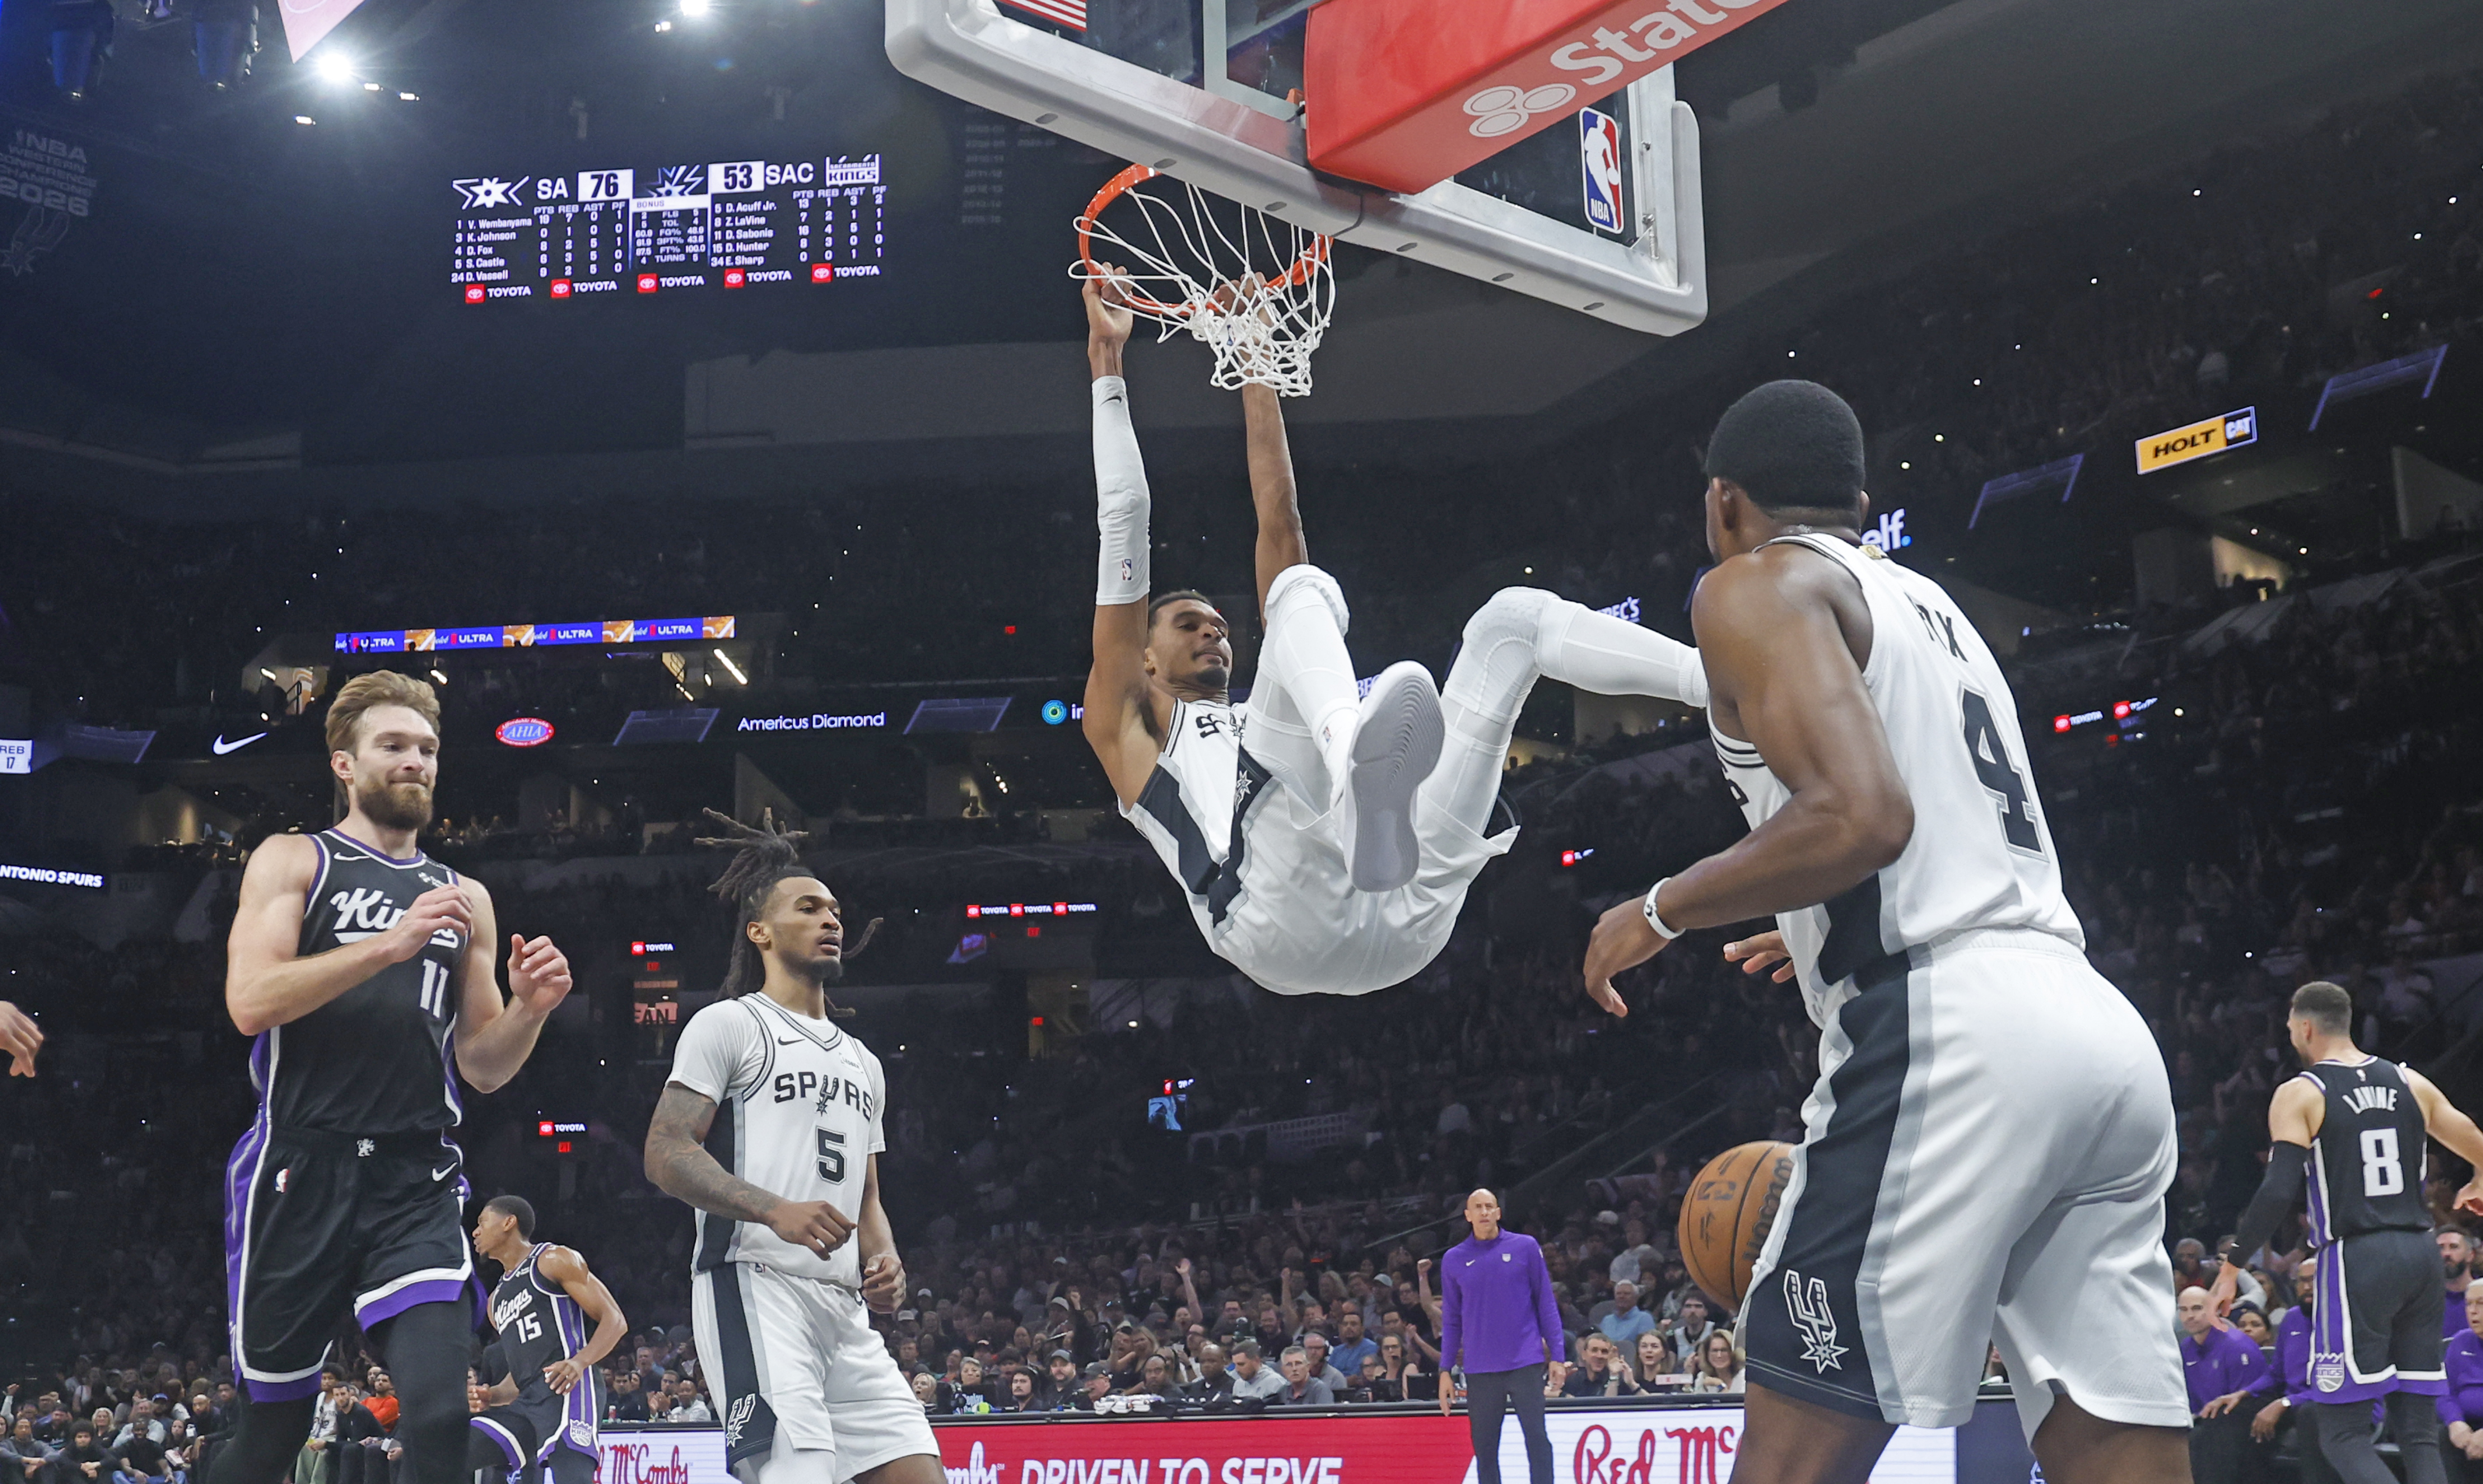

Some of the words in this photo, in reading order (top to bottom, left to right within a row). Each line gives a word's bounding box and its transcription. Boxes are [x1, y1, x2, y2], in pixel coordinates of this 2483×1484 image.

[1550, 0, 1760, 86] Stat
[26, 132, 87, 164] NBA
[9, 144, 85, 174] WESTERN
[724, 164, 753, 190] 53
[766, 162, 814, 185] SAC
[829, 169, 876, 181] KINGS
[537, 177, 568, 199] SA
[591, 173, 618, 198] 76
[793, 190, 814, 199] PTS
[818, 188, 840, 198] REB
[843, 187, 865, 196] AST
[872, 186, 886, 195] PF
[0, 176, 88, 216] 2026
[725, 202, 735, 213] D.
[736, 200, 762, 213] Acuff
[763, 200, 777, 211] Jr.
[799, 199, 809, 209] 13
[827, 197, 831, 207] 1
[850, 196, 857, 206] 3
[875, 194, 883, 204] 2
[534, 206, 554, 215] PTS
[558, 205, 579, 213] REB
[584, 203, 604, 212] AST
[612, 202, 625, 210] PF
[642, 212, 647, 220] 2
[725, 217, 734, 227] Z.
[735, 216, 766, 226] LaVine
[800, 212, 808, 222] 7
[825, 210, 832, 221] 2
[851, 209, 856, 219] 1
[877, 208, 882, 218] 1
[1590, 198, 1610, 223] NBA
[457, 220, 462, 229] 1
[468, 220, 476, 229] V.
[479, 218, 532, 230] Wembanyama
[566, 213, 572, 223] 7
[591, 212, 598, 221] 0
[617, 210, 622, 220] 1
[456, 233, 463, 242] 3
[467, 232, 476, 242] K.
[477, 232, 516, 241] Johnson
[540, 228, 548, 238] 0
[567, 227, 571, 236] 1
[590, 225, 598, 235] 0
[615, 223, 623, 233] 0
[659, 228, 681, 237] FG%
[714, 231, 721, 240] 11
[725, 231, 735, 241] D.
[736, 228, 774, 238] Sabonis
[824, 225, 832, 234] 4
[877, 221, 881, 231] 1
[455, 246, 462, 256] 4
[467, 246, 476, 256] D.
[477, 246, 493, 255] Fox
[565, 240, 572, 250] 2
[590, 238, 598, 248] 5
[616, 237, 621, 246] 1
[656, 237, 684, 245] 3PT%
[686, 244, 706, 253] 100.0
[713, 243, 722, 253] 15
[725, 243, 735, 253] D.
[736, 242, 769, 251] Hunter
[825, 237, 832, 247] 3
[850, 236, 857, 245] 0
[875, 234, 883, 244] 0
[466, 259, 474, 269] S.
[475, 257, 505, 268] Castle
[614, 249, 622, 260] 0
[641, 256, 646, 265] 4
[655, 254, 685, 263] TURNS
[711, 257, 724, 267] 34
[725, 256, 734, 266] E.
[735, 255, 764, 265] Sharp
[800, 252, 807, 262] 0
[825, 250, 832, 260] 0
[851, 249, 856, 259] 1
[876, 248, 881, 258] 1
[451, 272, 464, 283] 24
[465, 272, 475, 282] D.
[476, 269, 509, 281] Vassell
[564, 265, 572, 276] 2
[614, 262, 622, 273] 0
[747, 271, 792, 282] TOYOTA
[834, 266, 880, 277] TOYOTA
[572, 281, 618, 292] TOYOTA
[660, 275, 705, 288] TOYOTA
[487, 286, 531, 297] TOYOTA
[2225, 417, 2251, 440] CAT
[2153, 428, 2217, 458] HOLT
[459, 634, 493, 643] ULTRA
[558, 630, 593, 639] ULTRA
[658, 625, 693, 635] ULTRA
[507, 726, 542, 737] AHIA
[738, 715, 809, 732] Americus
[813, 712, 884, 728] Diamond
[7, 757, 15, 769] 17
[1958, 681, 2050, 863] 4
[58, 872, 102, 887] SPURS
[646, 943, 674, 951] TOYOTA
[420, 959, 449, 1018] 11
[774, 1071, 873, 1122] SPURS
[554, 1123, 586, 1132] TOYOTA
[816, 1125, 846, 1186] 5
[2359, 1128, 2404, 1196] 8
[494, 1289, 532, 1335] Kings
[516, 1311, 542, 1344] 15
[1574, 1424, 1655, 1484] Red
[1664, 1426, 1743, 1484] Mc
[1021, 1458, 1149, 1484] DRIVEN
[1158, 1458, 1210, 1484] TO
[1221, 1457, 1343, 1484] SERVE
